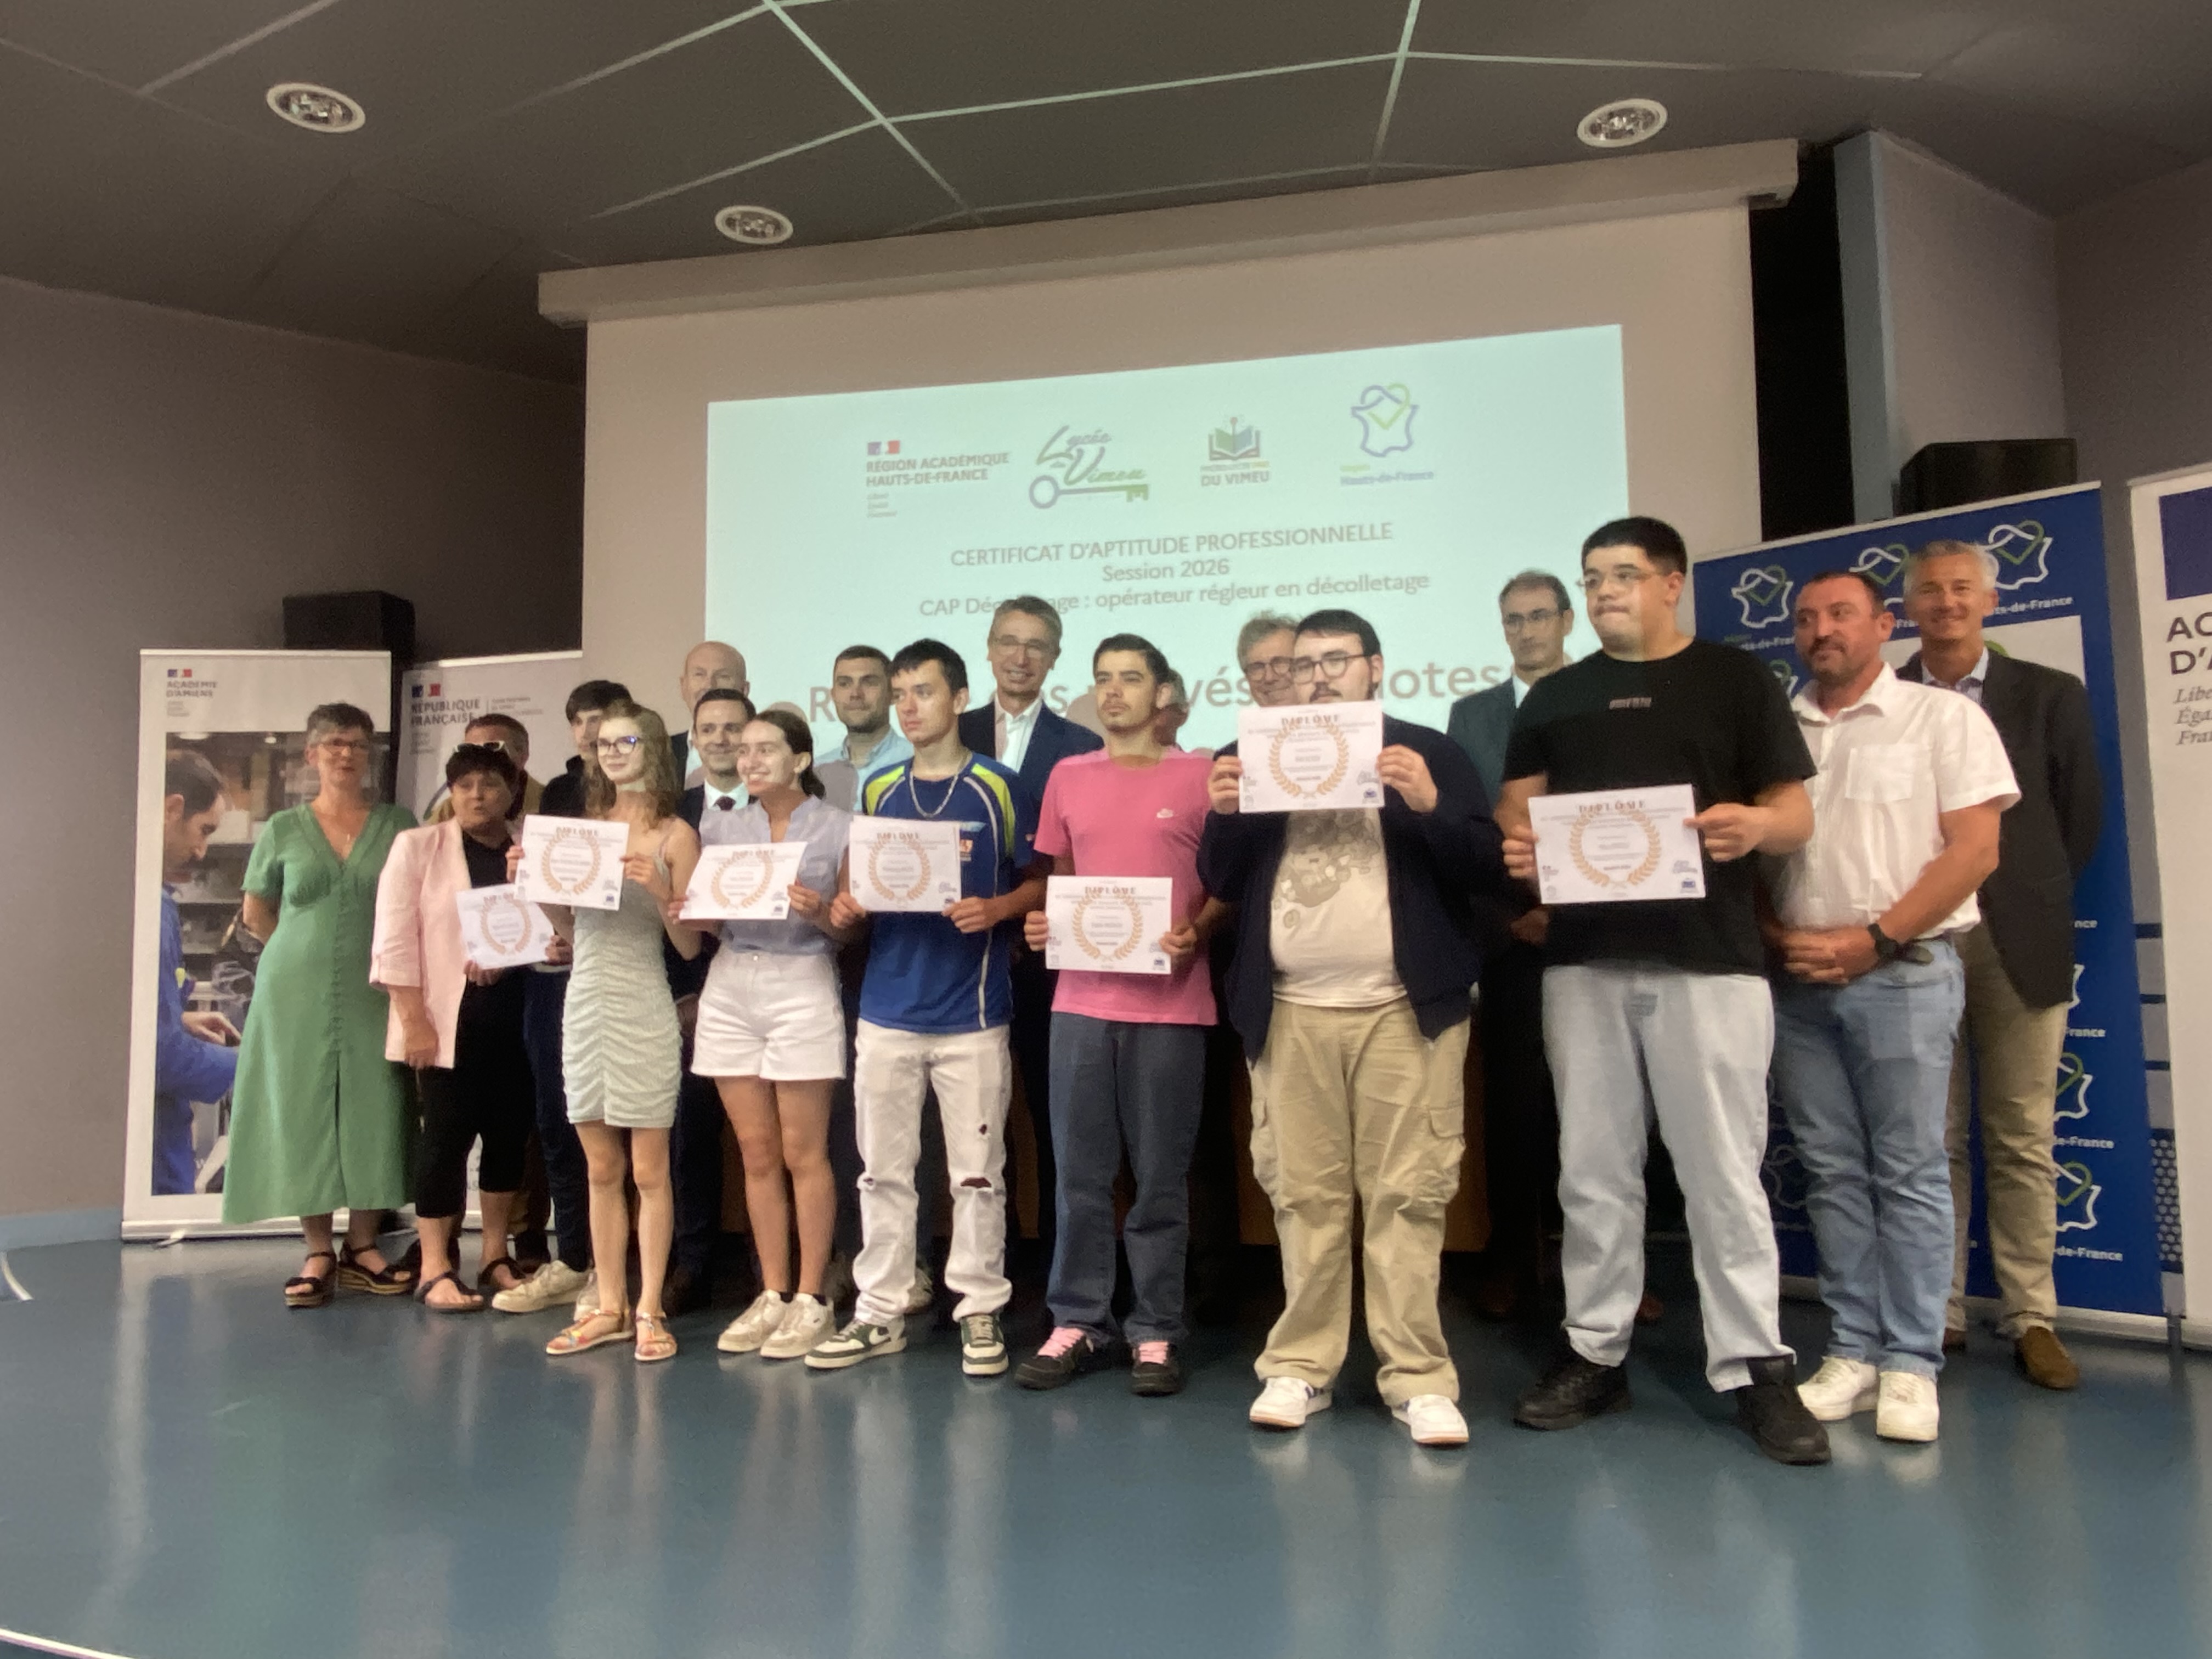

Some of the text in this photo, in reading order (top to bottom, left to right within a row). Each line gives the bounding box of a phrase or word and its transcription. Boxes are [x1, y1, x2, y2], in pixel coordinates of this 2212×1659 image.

[866, 468, 989, 487] HAUTS-DE-FRANCE
[950, 522, 1393, 566] CERTIFICAT D'APTITUDE PROFESSIONNELLE
[1102, 558, 1230, 582] Session 2026
[919, 598, 961, 616] CAP
[1096, 588, 1193, 611] opérateur
[1199, 582, 1269, 605] régleur
[1274, 583, 1300, 597] en
[1306, 574, 1430, 595] décolletage
[410, 698, 481, 713] RÉPUBLIQUE
